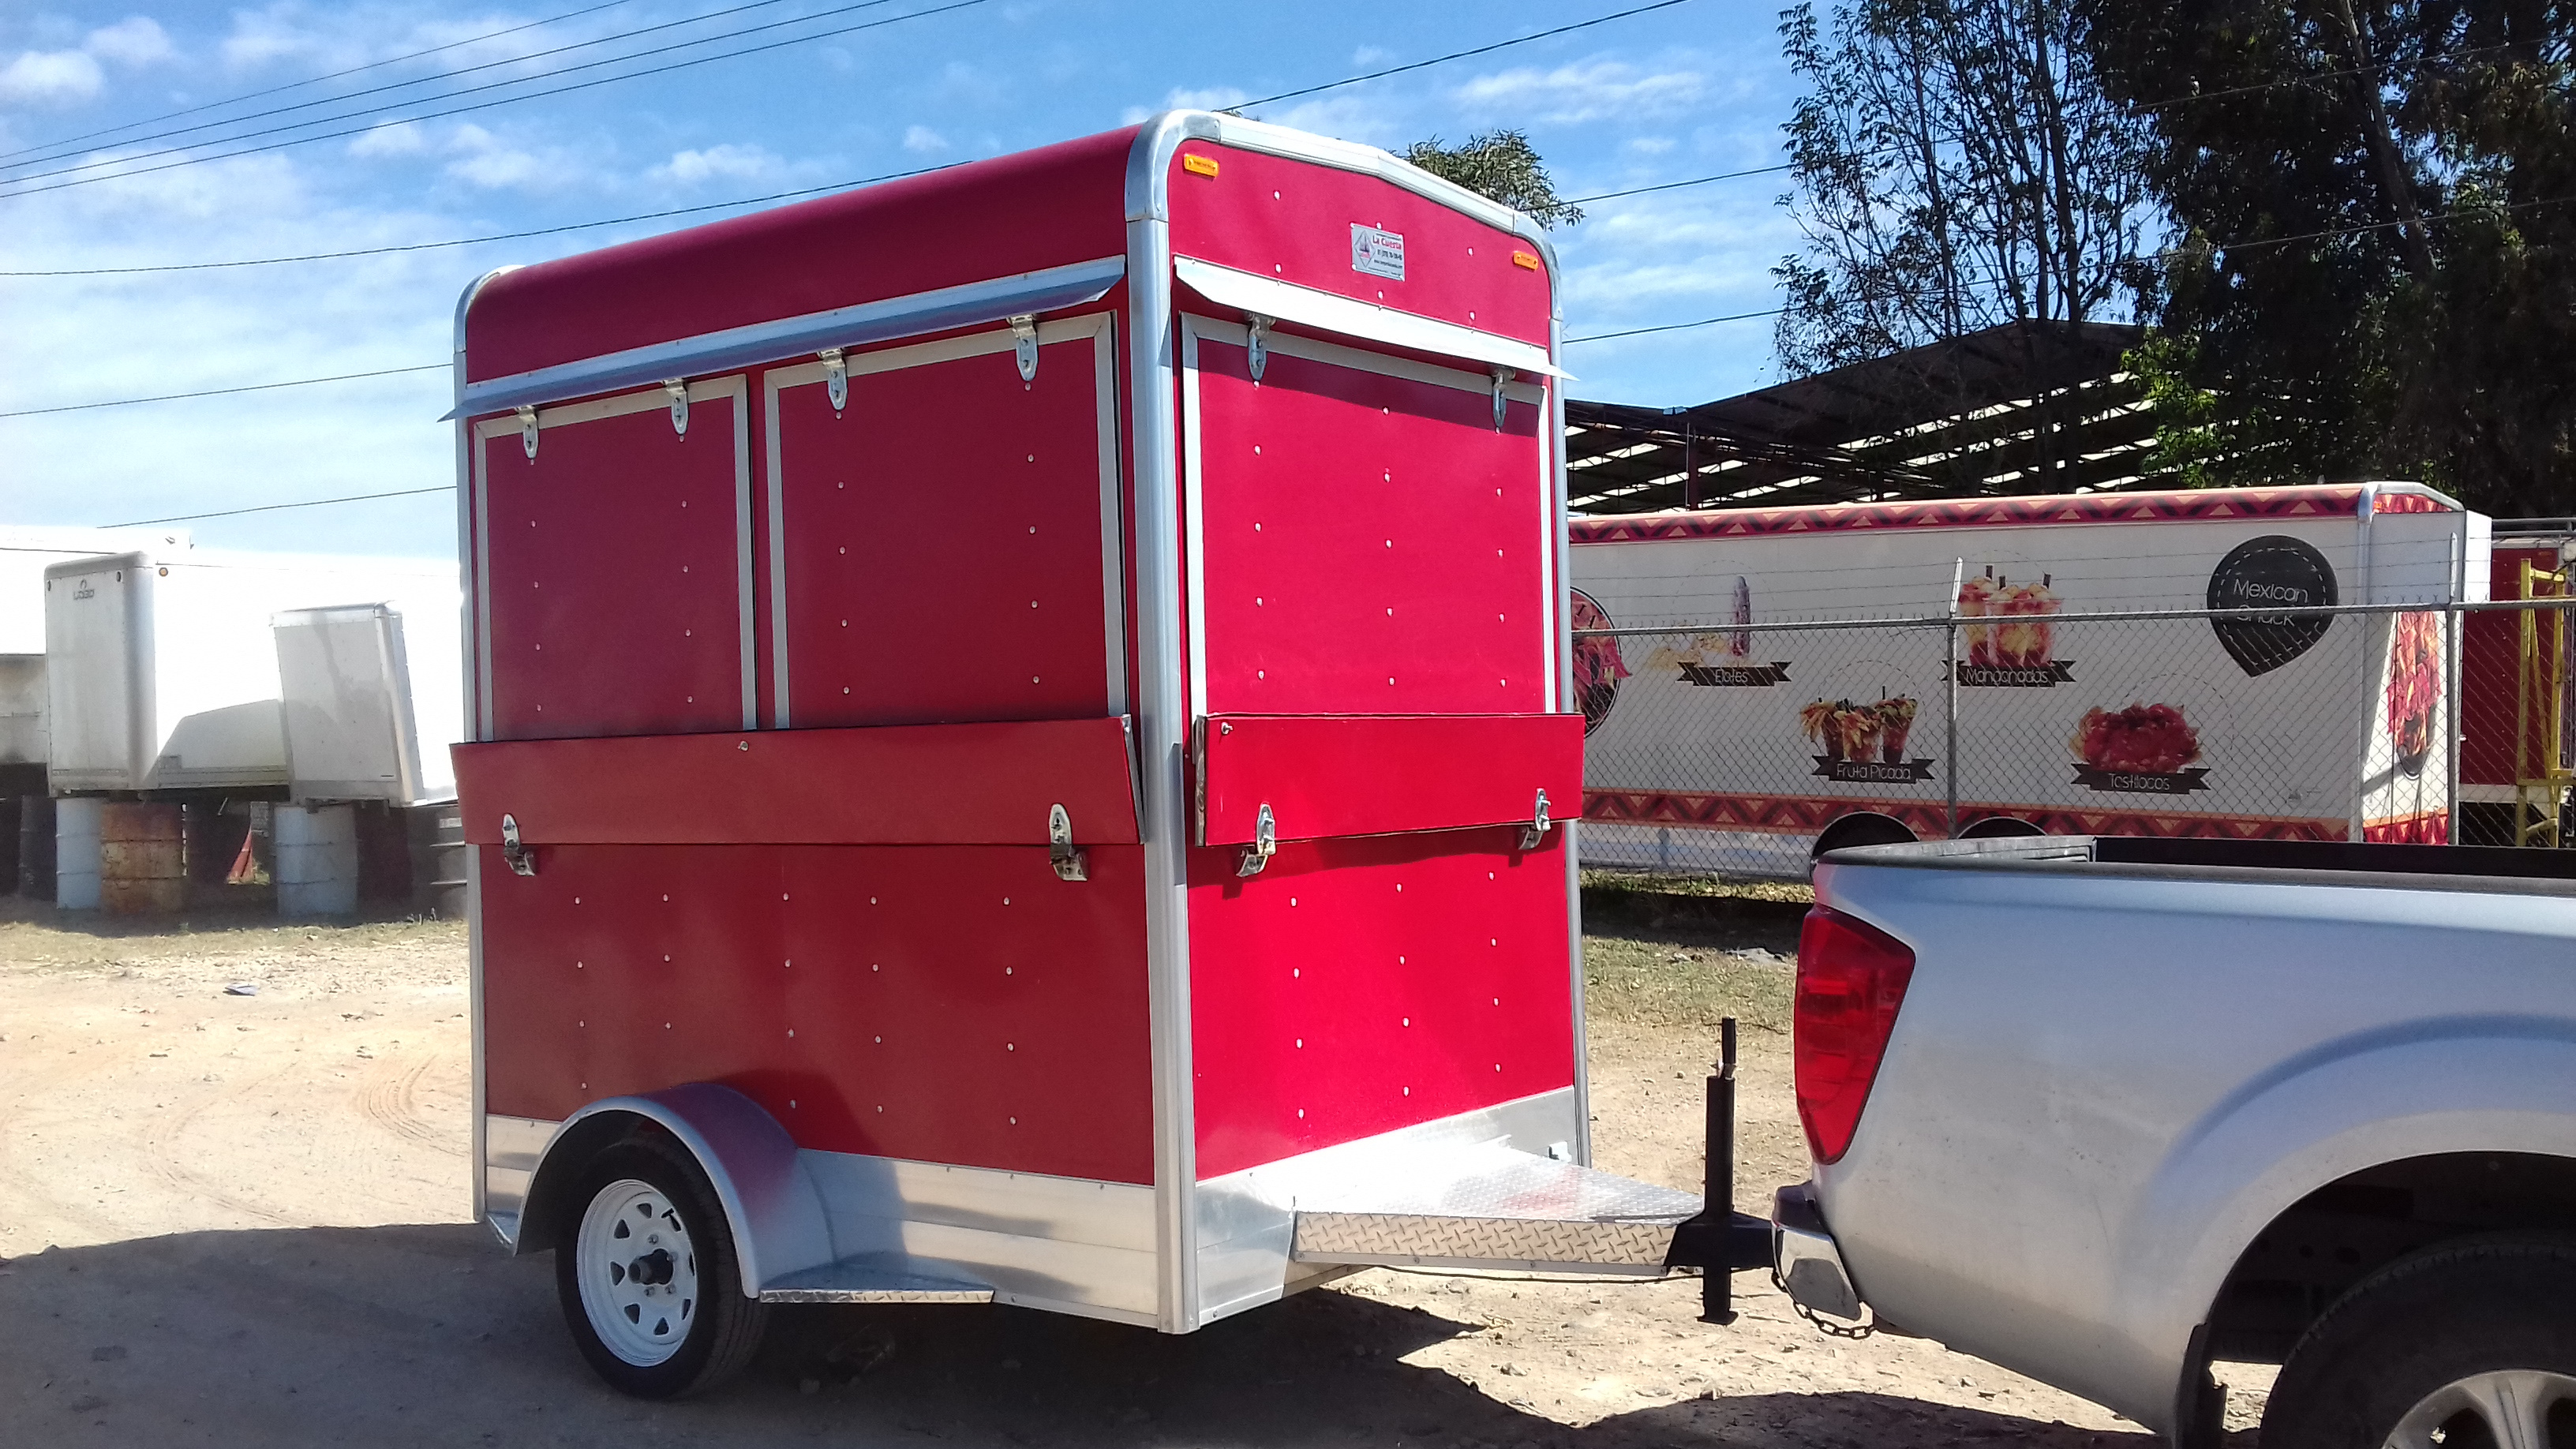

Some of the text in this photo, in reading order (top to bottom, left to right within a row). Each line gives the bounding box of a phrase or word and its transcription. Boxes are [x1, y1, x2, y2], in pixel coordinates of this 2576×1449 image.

[2233, 578, 2308, 604] Mexican
[1715, 668, 1748, 683] Elotes
[1837, 763, 1911, 780] Fruta Picada
